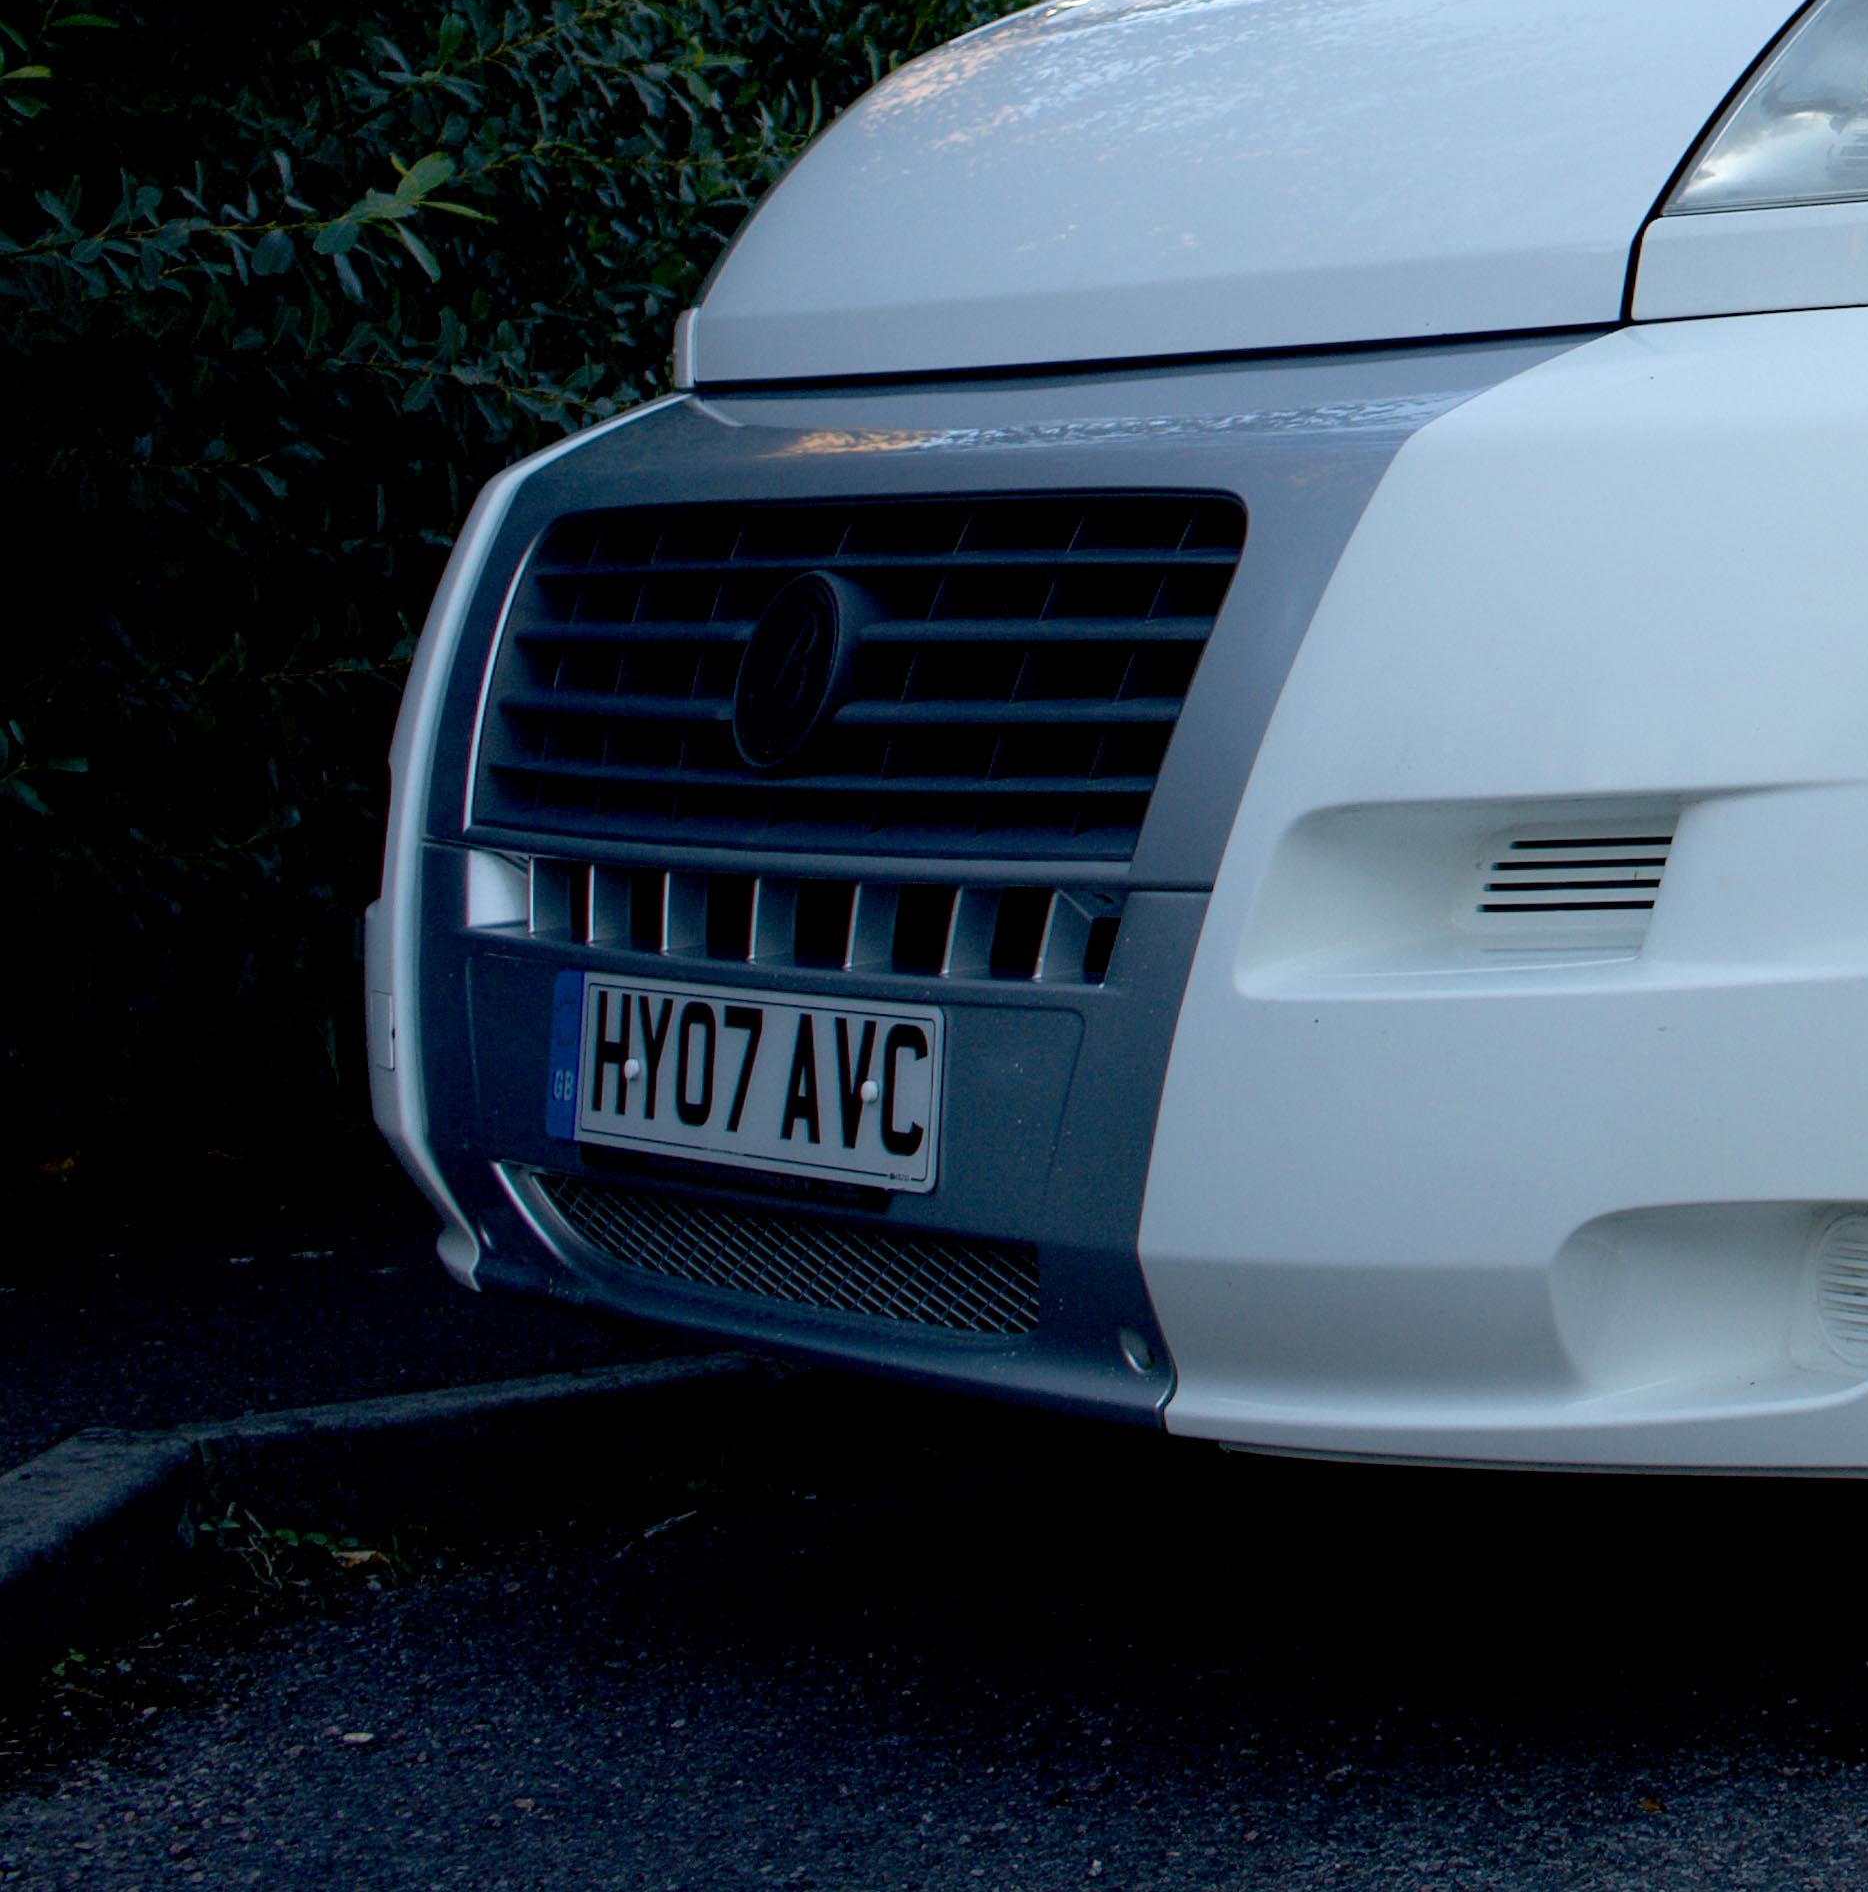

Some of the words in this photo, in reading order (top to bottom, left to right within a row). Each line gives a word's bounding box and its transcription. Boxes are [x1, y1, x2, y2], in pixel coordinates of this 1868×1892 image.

[553, 1068, 574, 1101] GB
[592, 990, 764, 1133] HY07
[779, 1012, 929, 1157] AVC
